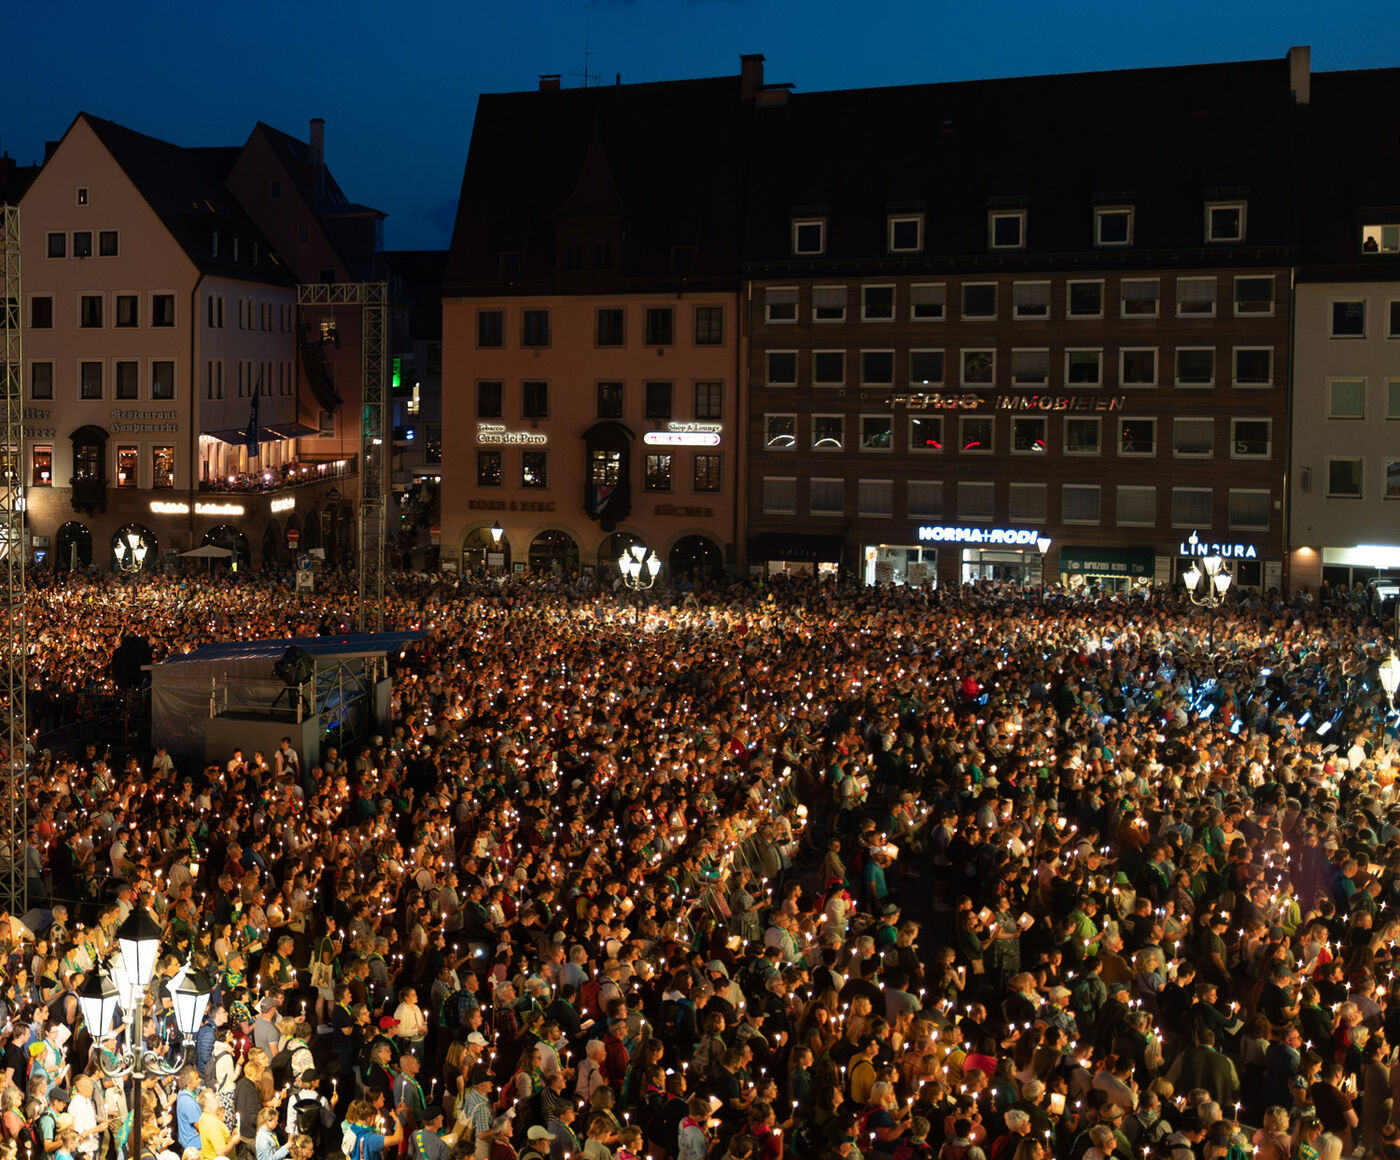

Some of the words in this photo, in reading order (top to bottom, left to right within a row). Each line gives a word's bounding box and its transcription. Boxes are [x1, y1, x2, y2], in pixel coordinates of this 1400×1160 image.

[995, 395, 1125, 411] IMMOBILIEN
[111, 409, 177, 420] Restaurant
[110, 422, 178, 434] Hauptmarkt
[669, 423, 685, 432] Shop
[687, 423, 693, 431] &
[694, 423, 721, 433] Lounge
[477, 433, 501, 444] Casa
[503, 433, 518, 444] del
[520, 433, 546, 444] Puro
[918, 526, 1039, 545] NORMA+RODI
